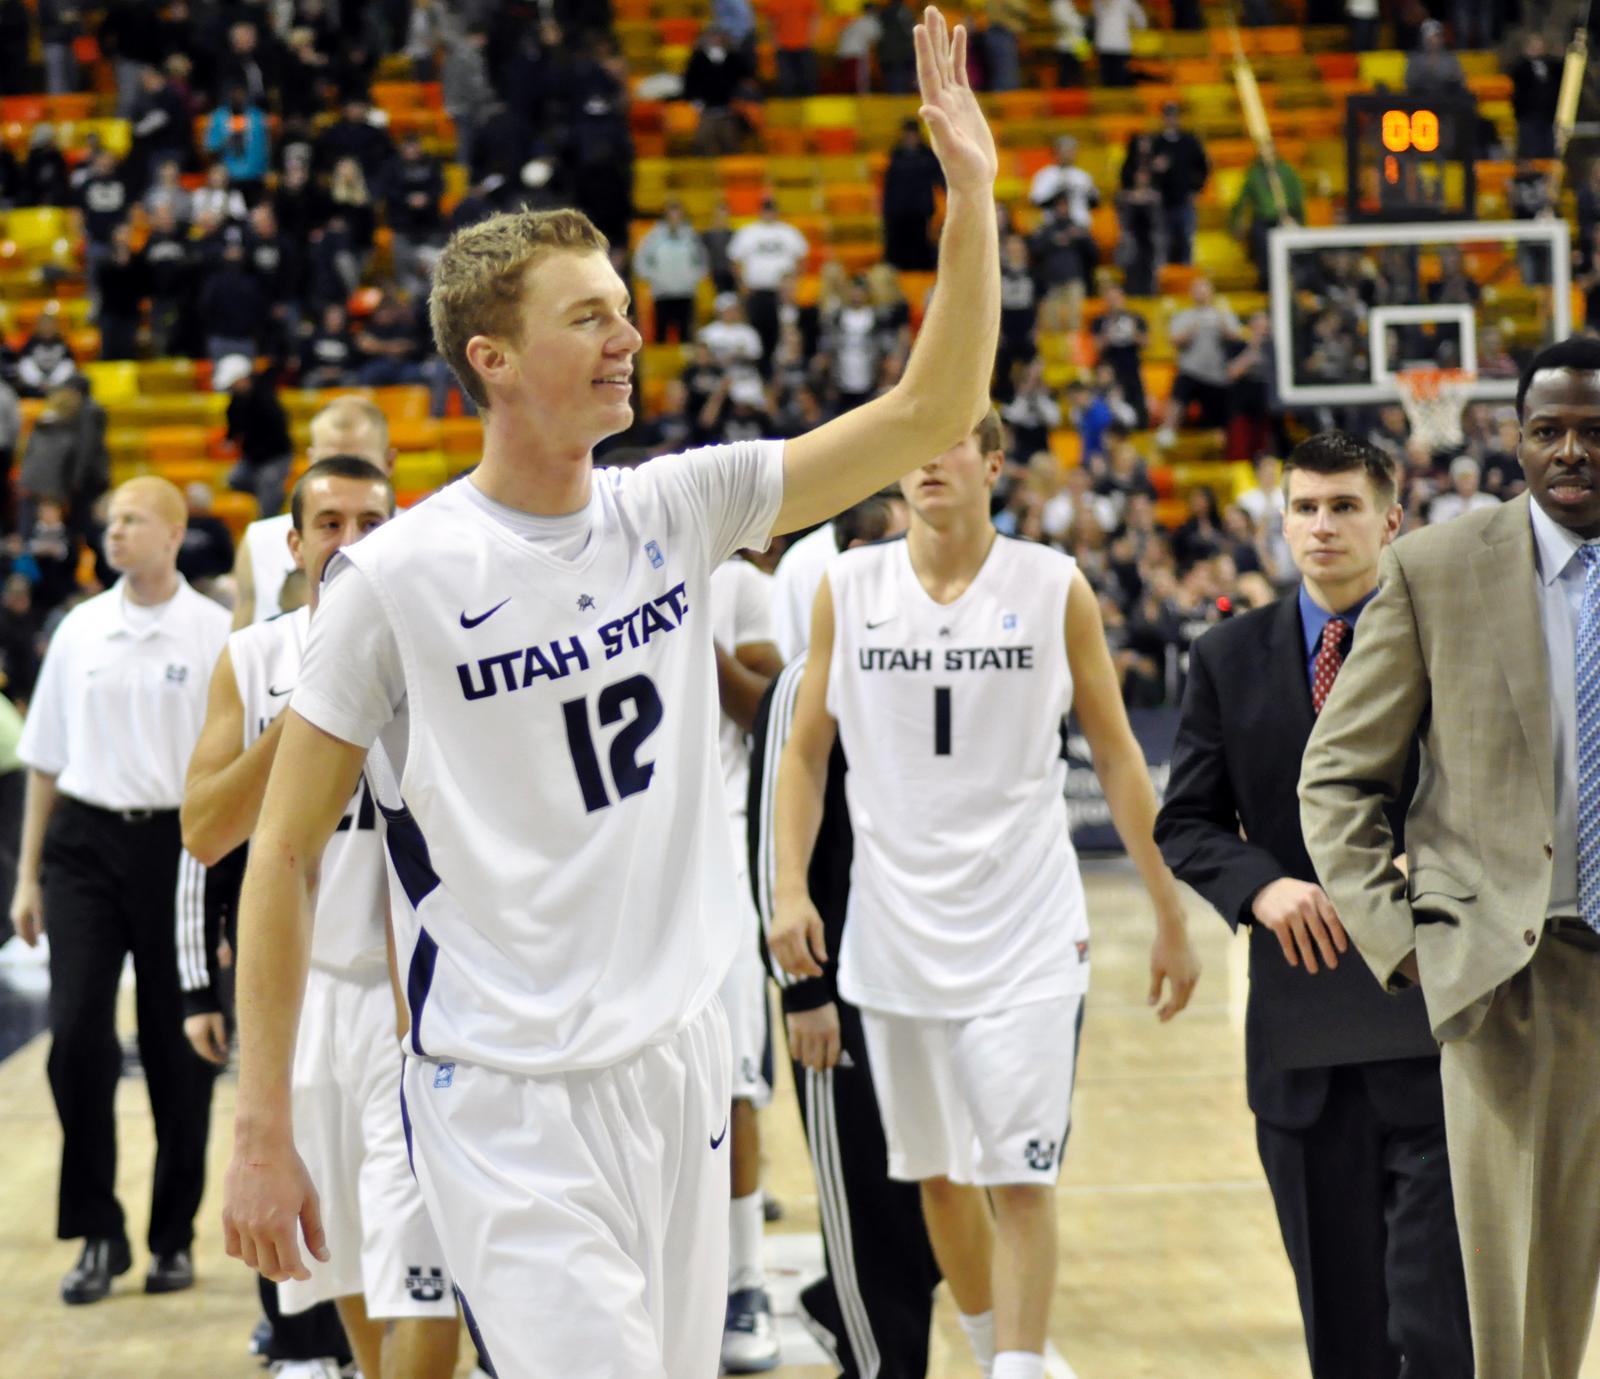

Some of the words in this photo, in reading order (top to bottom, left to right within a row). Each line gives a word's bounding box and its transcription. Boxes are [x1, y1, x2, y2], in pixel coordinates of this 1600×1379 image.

[456, 635, 590, 701] UTAH
[859, 647, 932, 671] UTAH
[945, 645, 1034, 671] STATE
[562, 671, 664, 815] 12
[934, 686, 952, 756] 1
